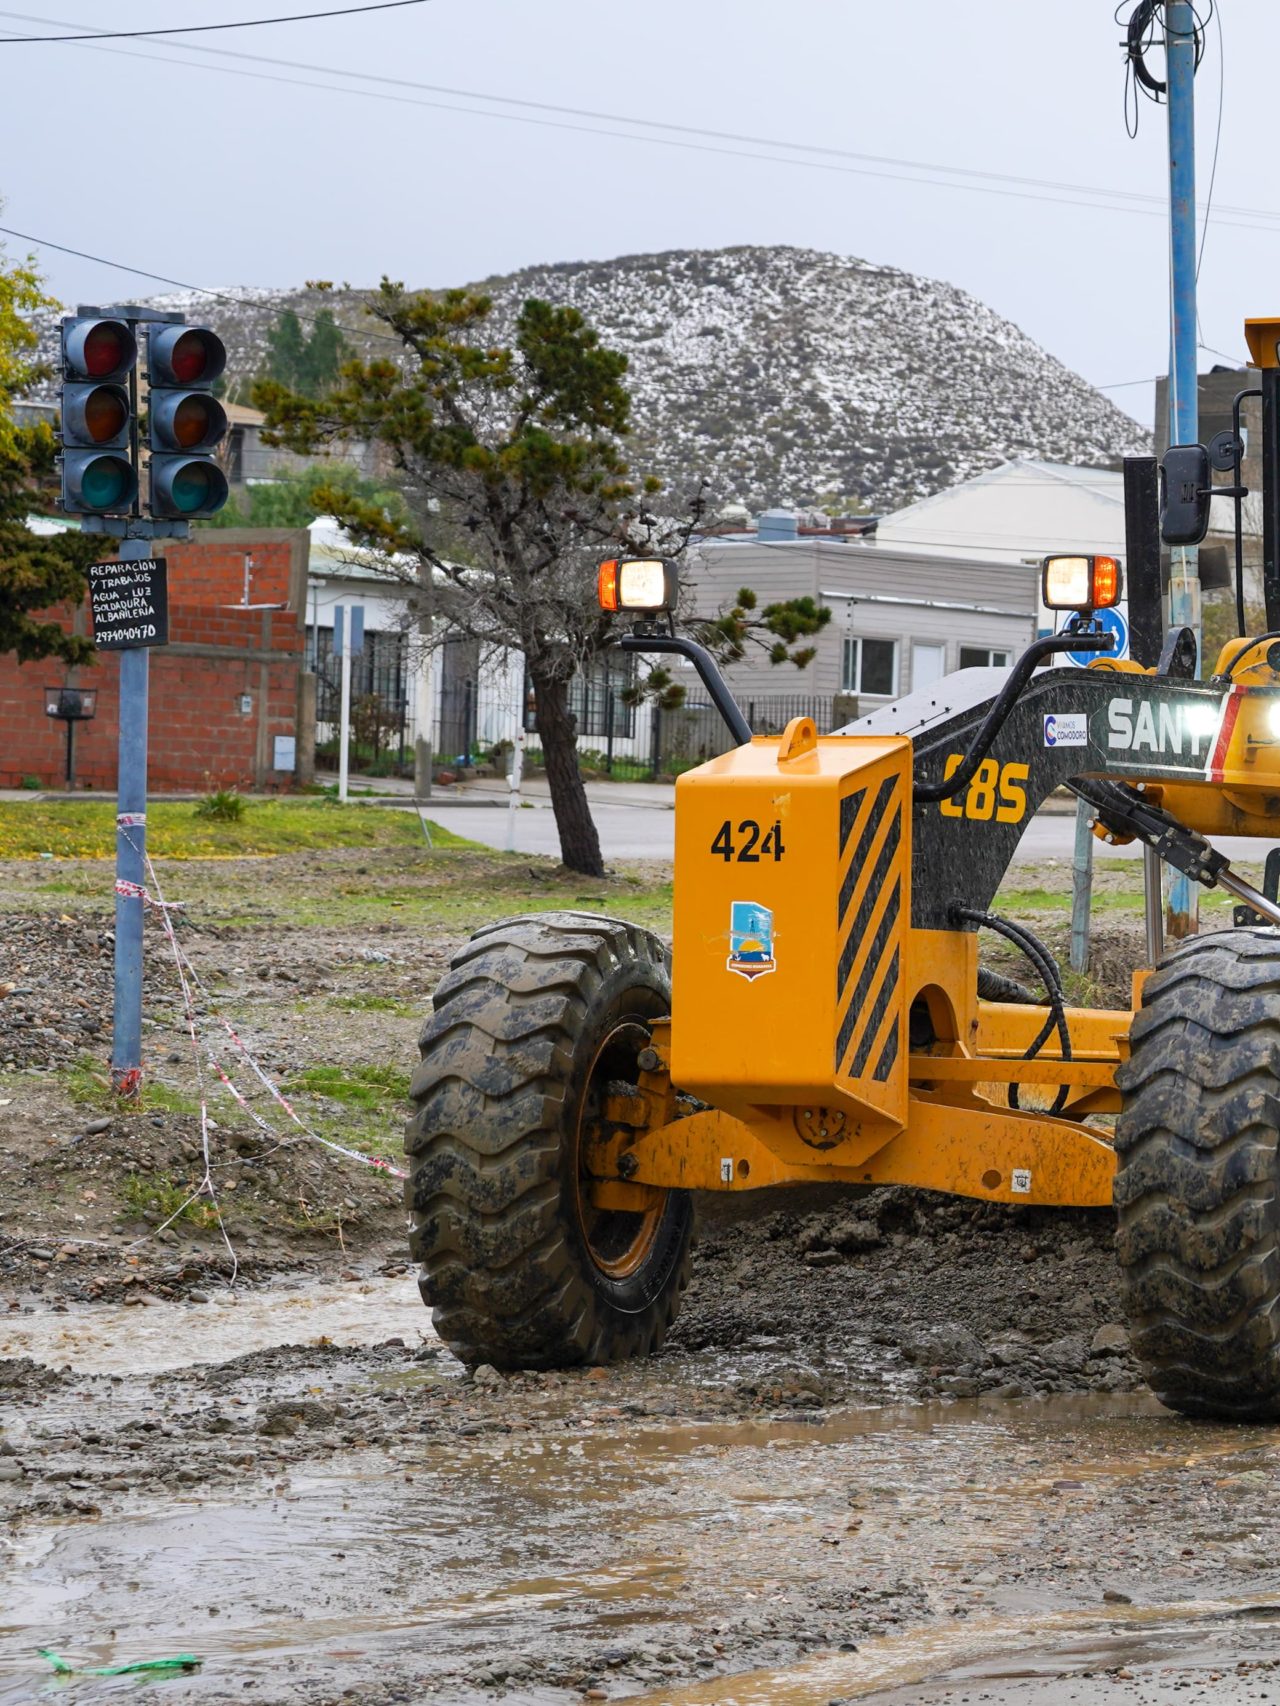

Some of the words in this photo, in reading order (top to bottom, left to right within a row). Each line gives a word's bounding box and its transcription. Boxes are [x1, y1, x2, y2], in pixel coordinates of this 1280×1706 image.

[91, 580, 98, 589] Y
[100, 573, 152, 589] TRABAJOS
[93, 591, 119, 602] AGUA
[132, 587, 152, 597] LUZ
[93, 597, 148, 612] SOLDADURA
[95, 624, 156, 643] 2974040470
[1057, 730, 1087, 740] COMODORO
[711, 819, 785, 862] 424
